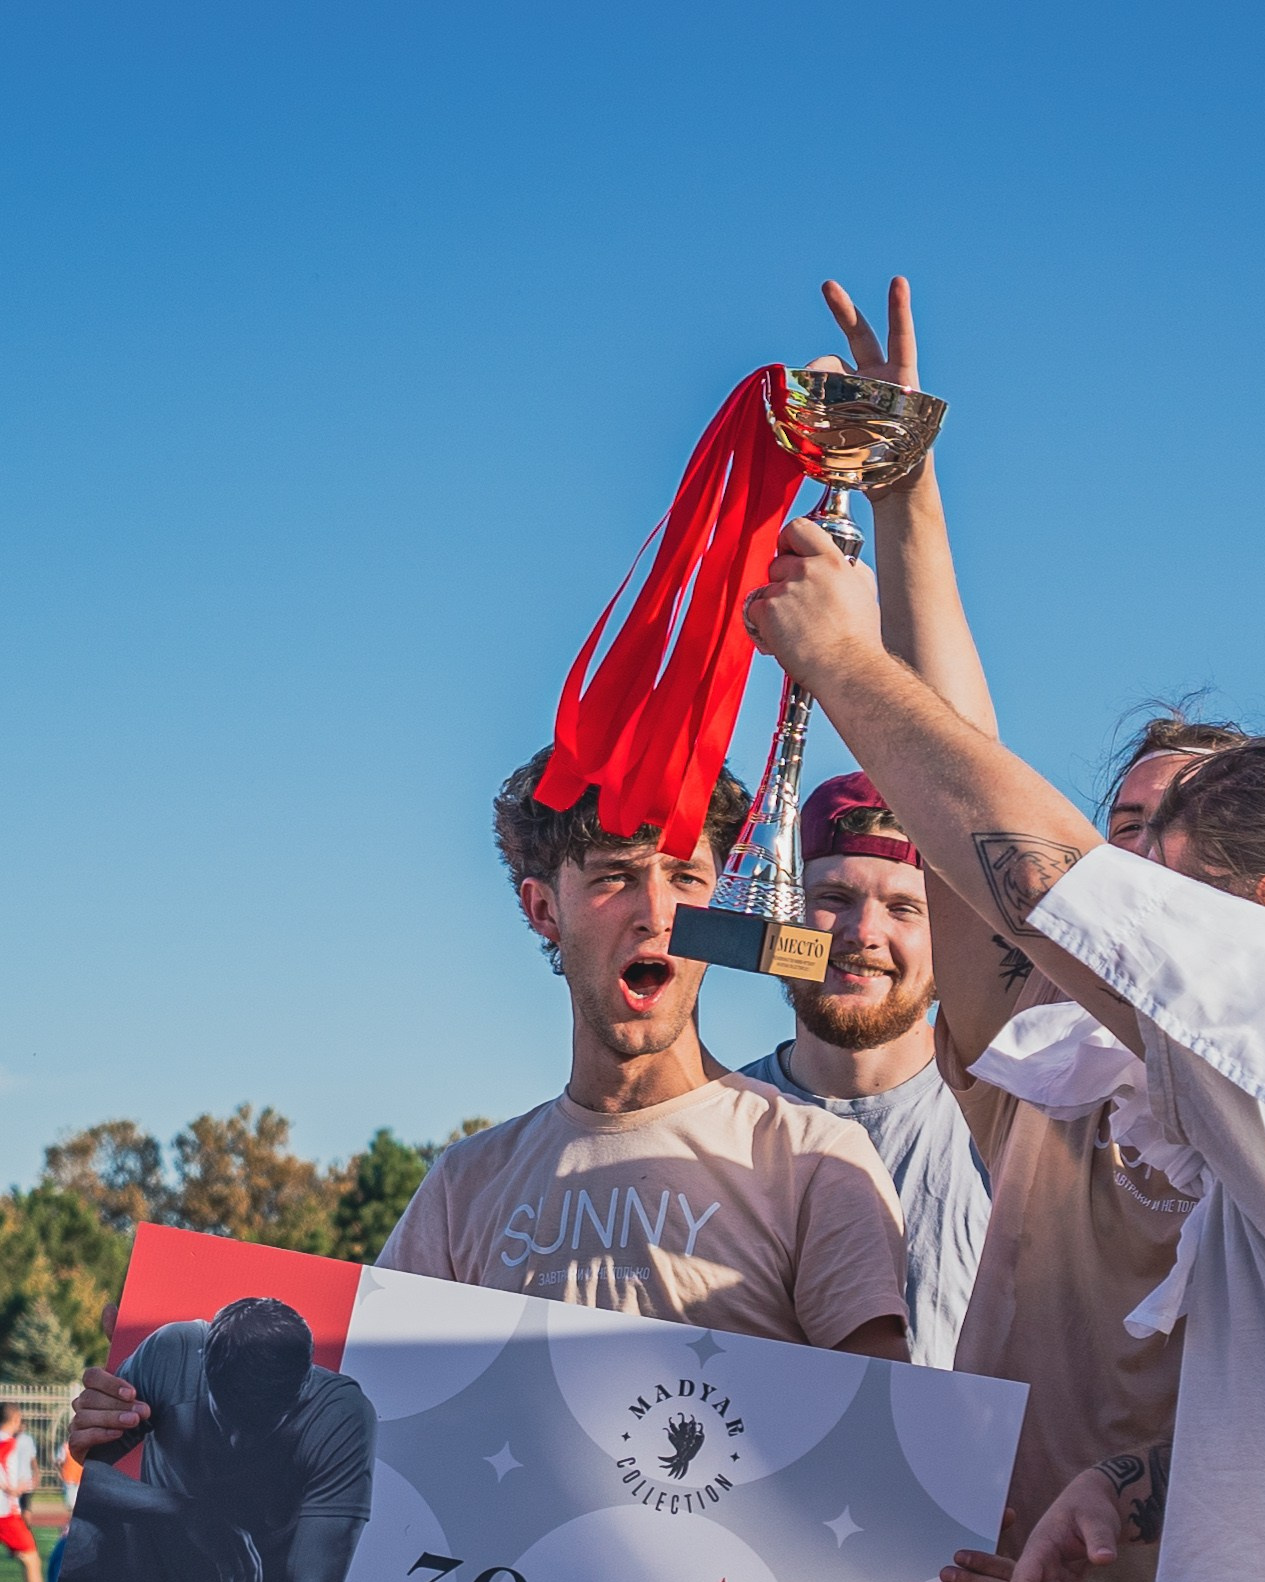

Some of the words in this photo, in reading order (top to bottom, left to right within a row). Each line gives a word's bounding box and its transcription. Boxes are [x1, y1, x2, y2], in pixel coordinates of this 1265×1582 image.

[778, 937, 824, 958] МЕСТО
[501, 1187, 721, 1267] SUNNY
[1161, 1200, 1176, 1212] НЕ
[628, 1379, 745, 1437] MADYAR
[616, 1457, 733, 1515] COLLECTION
